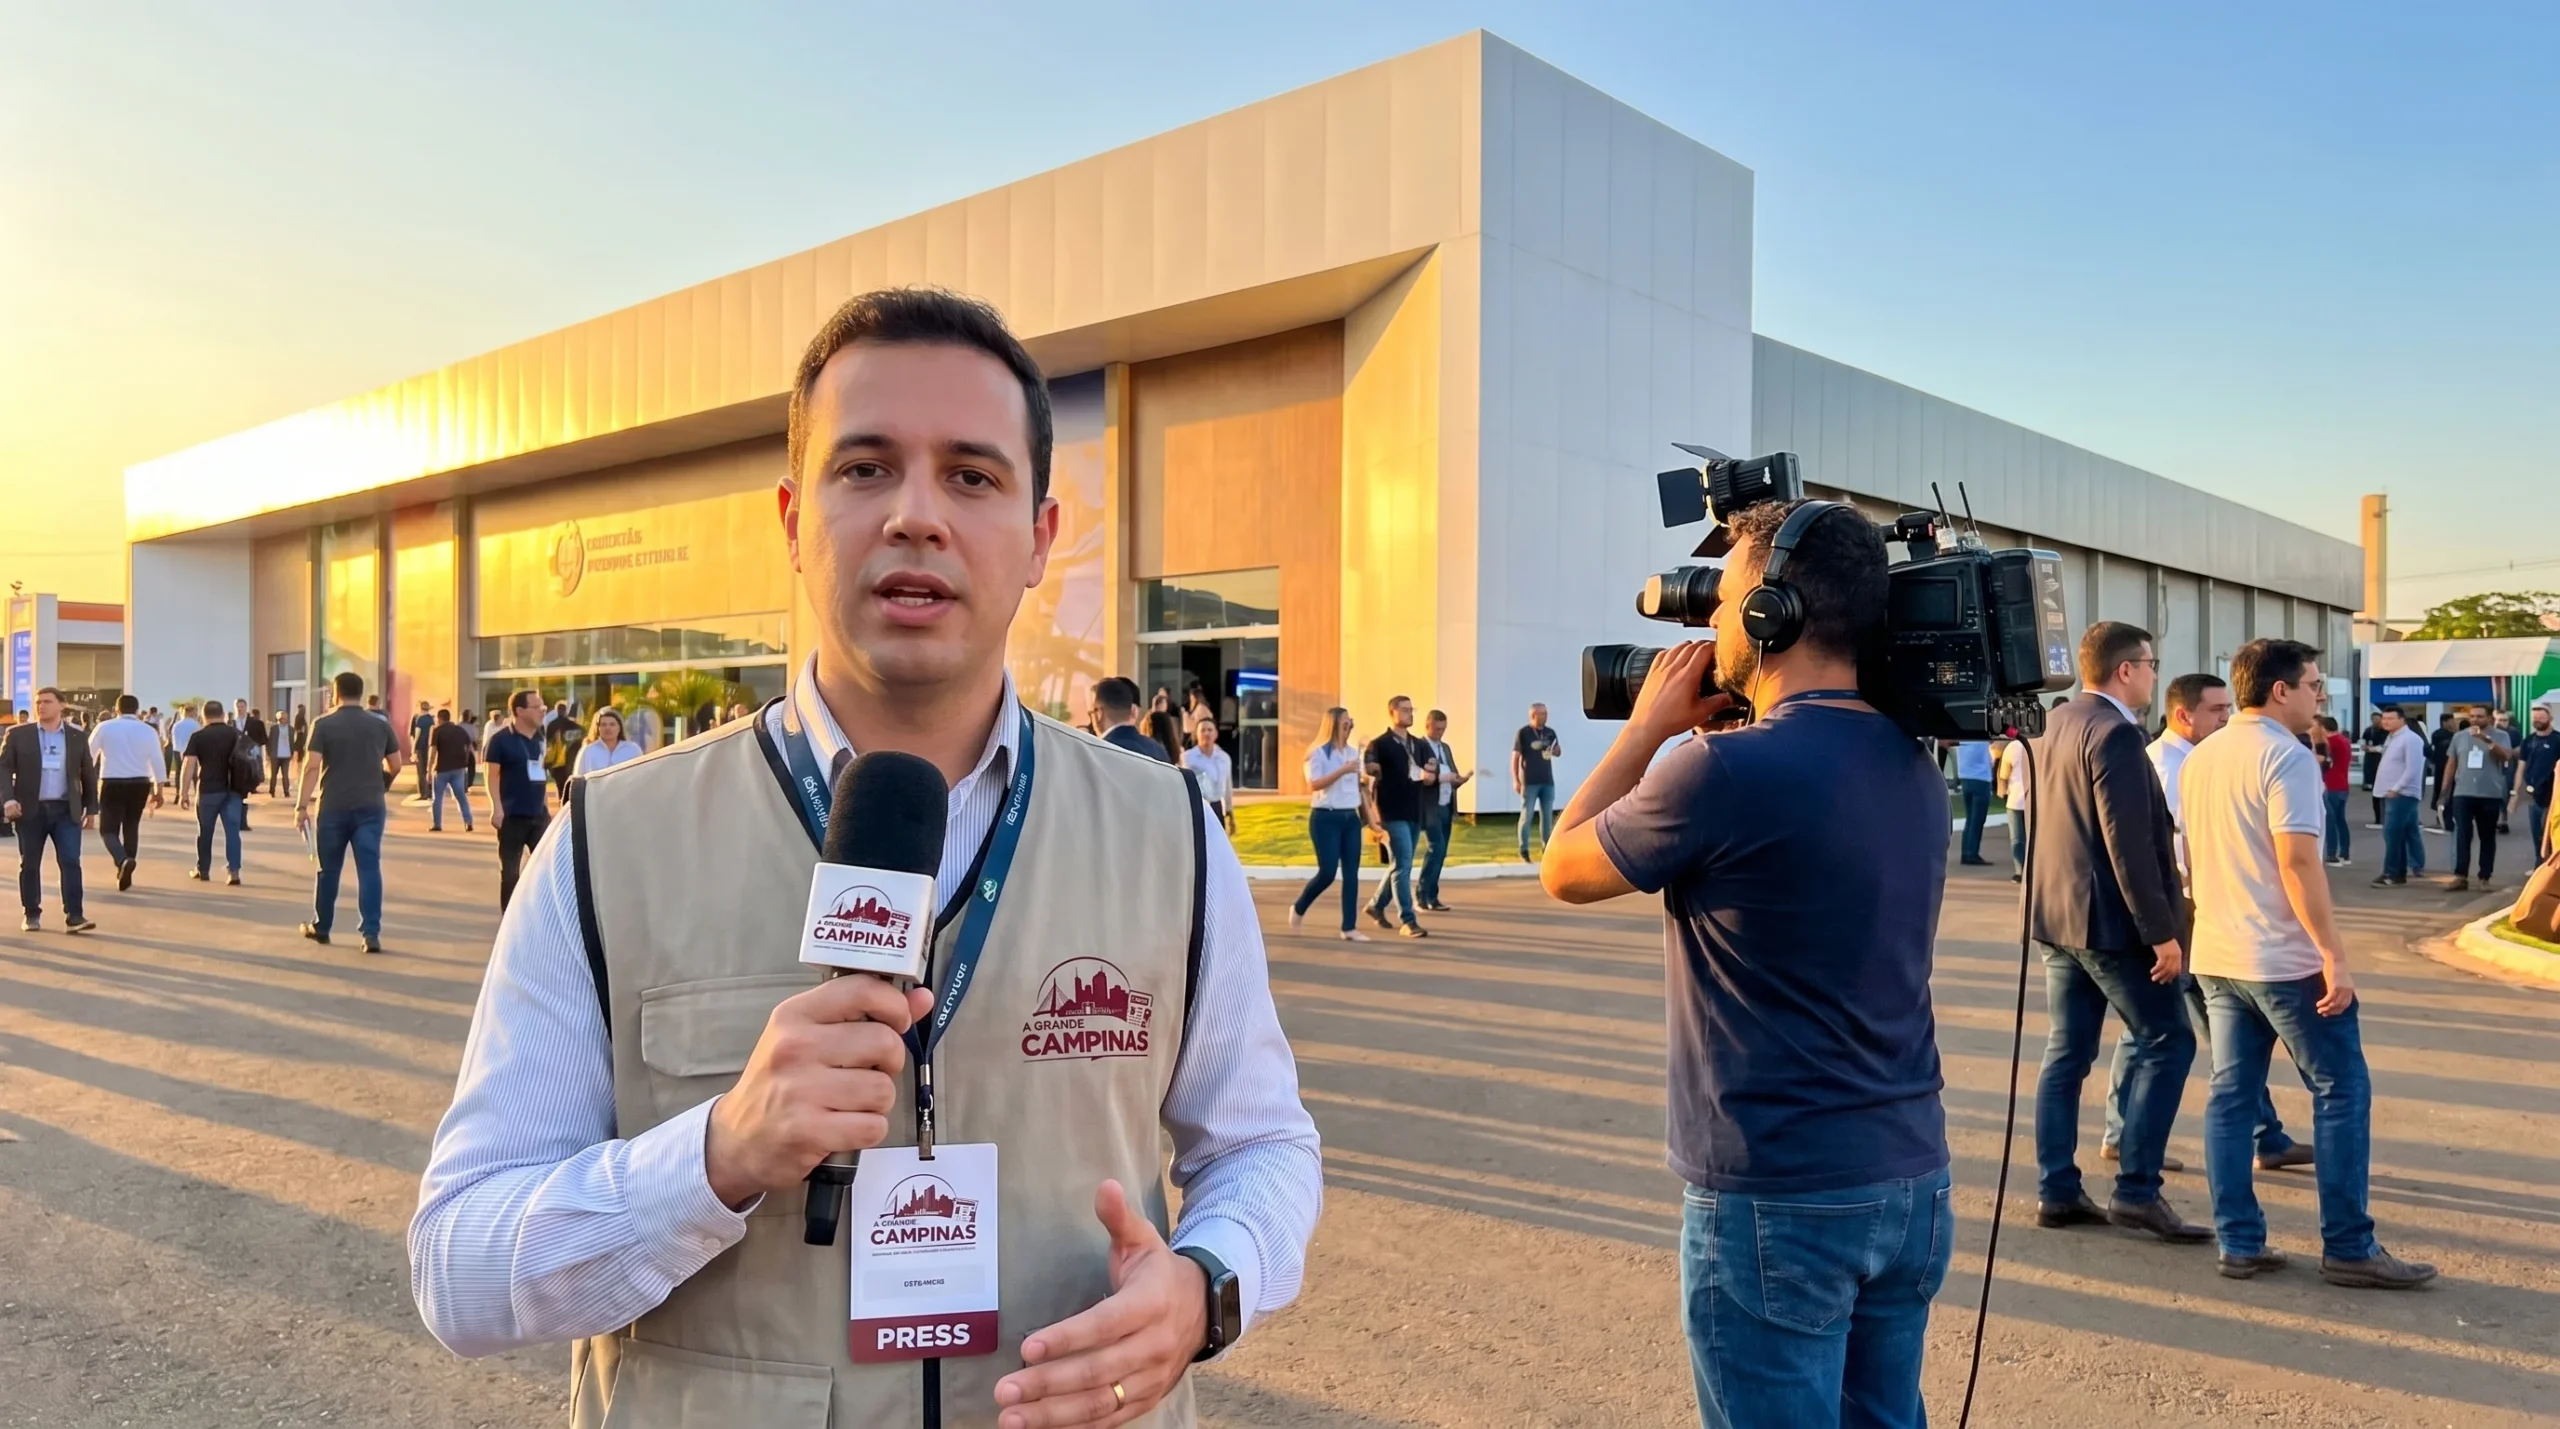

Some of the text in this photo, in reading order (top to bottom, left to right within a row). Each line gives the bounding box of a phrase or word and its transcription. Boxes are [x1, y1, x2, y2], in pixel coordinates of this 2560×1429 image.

[813, 926, 908, 949] CAMPINAS
[1022, 1018, 1085, 1032] A GRANDE
[1021, 1030, 1149, 1056] CAMPINAS
[870, 1224, 977, 1245] CAMPINAS
[873, 1220, 880, 1228] A
[876, 1323, 971, 1350] PRESS
